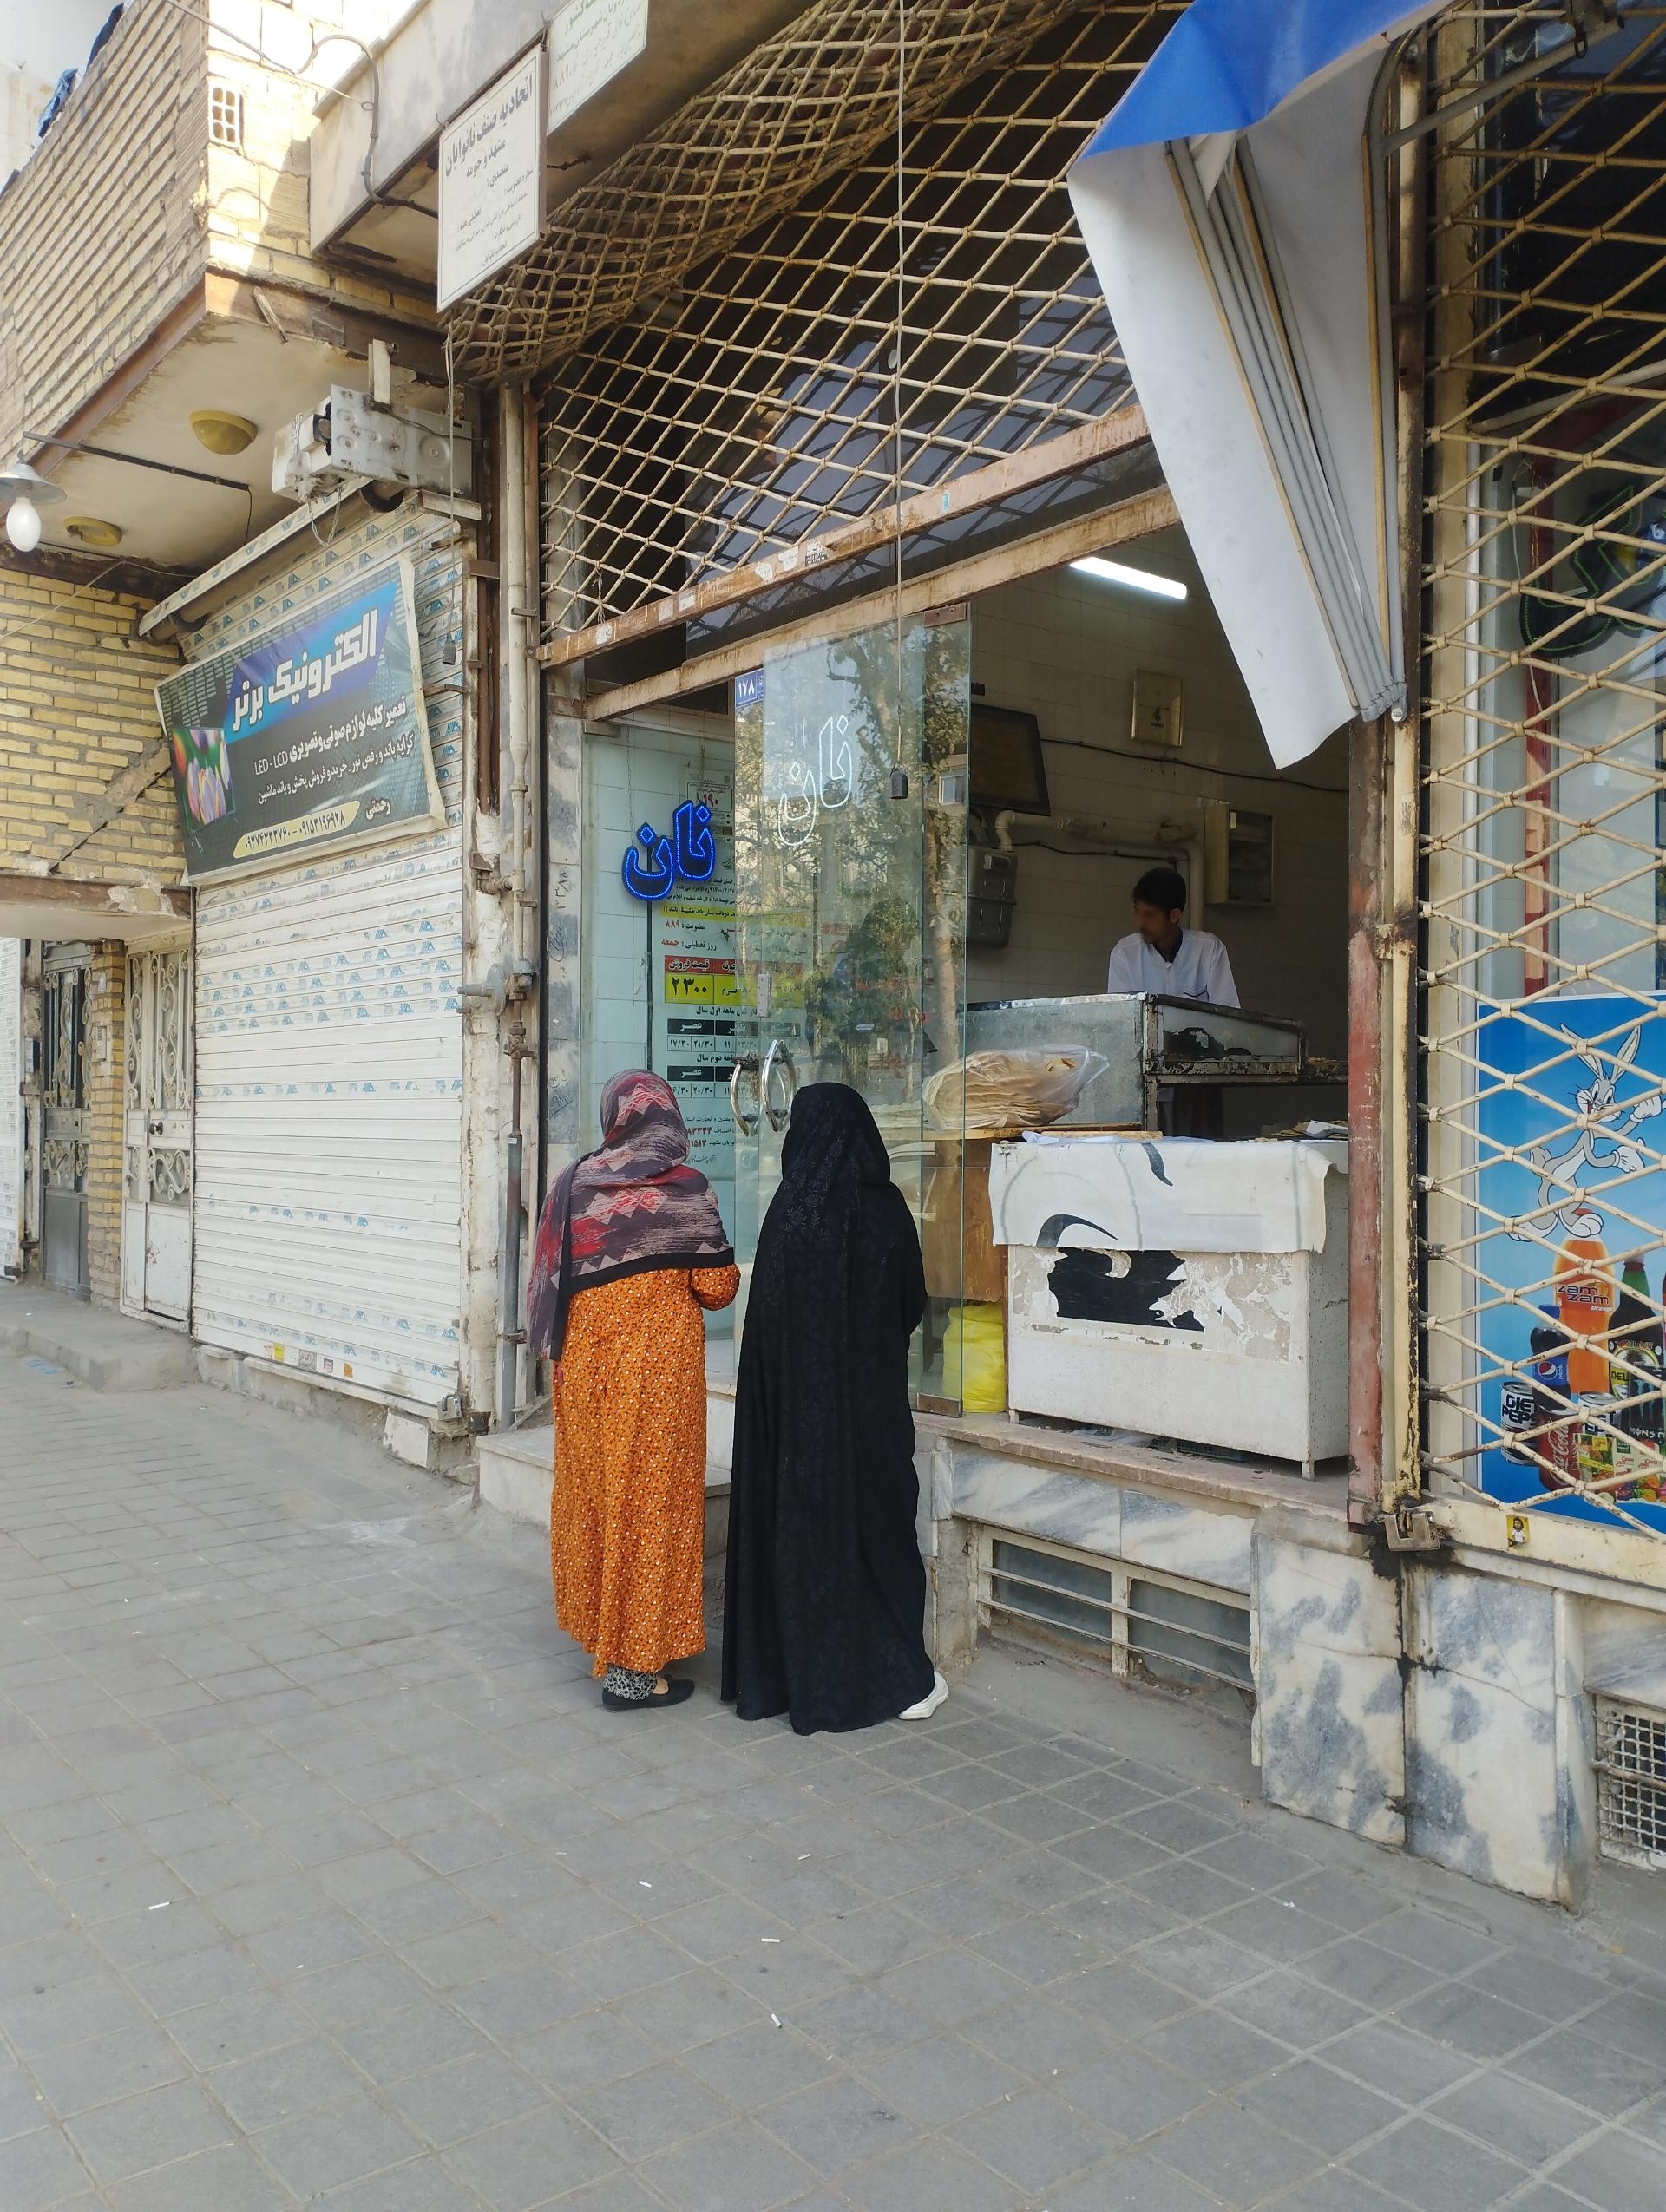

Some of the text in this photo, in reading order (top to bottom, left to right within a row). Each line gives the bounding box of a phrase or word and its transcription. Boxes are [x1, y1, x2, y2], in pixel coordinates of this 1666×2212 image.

[500, 73, 533, 127] اتحادیه
[477, 113, 497, 141] صنف
[446, 121, 476, 177] نانوایان
[489, 139, 506, 160] مشهد
[466, 159, 482, 178] حومه
[233, 609, 377, 732] الکترونیک برتر
[738, 678, 755, 698] ۱۷۸
[366, 704, 384, 730] کلیه
[385, 696, 407, 728] تعمیر
[345, 710, 367, 741] لوازم
[289, 731, 318, 763] تصویری
[323, 725, 345, 751] صوتی
[396, 731, 415, 755] کرایه
[361, 747, 378, 769] رقص
[383, 739, 397, 759] باند
[254, 757, 269, 776] LED
[272, 749, 289, 769] LCD
[331, 758, 348, 778] خرید
[291, 775, 309, 795] پخش
[309, 765, 327, 788] فروش
[777, 713, 852, 847] نان
[259, 785, 277, 805] ماشین
[276, 779, 288, 795] باند
[365, 797, 390, 821] رحمتی
[622, 799, 716, 902] نان
[665, 919, 681, 929] ۸۸۹
[669, 958, 710, 972] قیمت فروش
[671, 977, 707, 996] ۲۳۰۰
[696, 1006, 708, 1015] سال
[709, 1006, 721, 1016] اول
[680, 1022, 703, 1031] عصر
[670, 1039, 690, 1049] ۱۷/۳۰
[693, 1040, 712, 1049] ۲۱/۳۰
[696, 1054, 735, 1063] اهه دوم سال
[680, 1069, 702, 1078] عصر
[692, 1086, 712, 1095] ۲۰/۳۰
[1557, 1284, 1598, 1295] zam
[1567, 1293, 1609, 1305] zam
[1610, 1370, 1629, 1383] DEL
